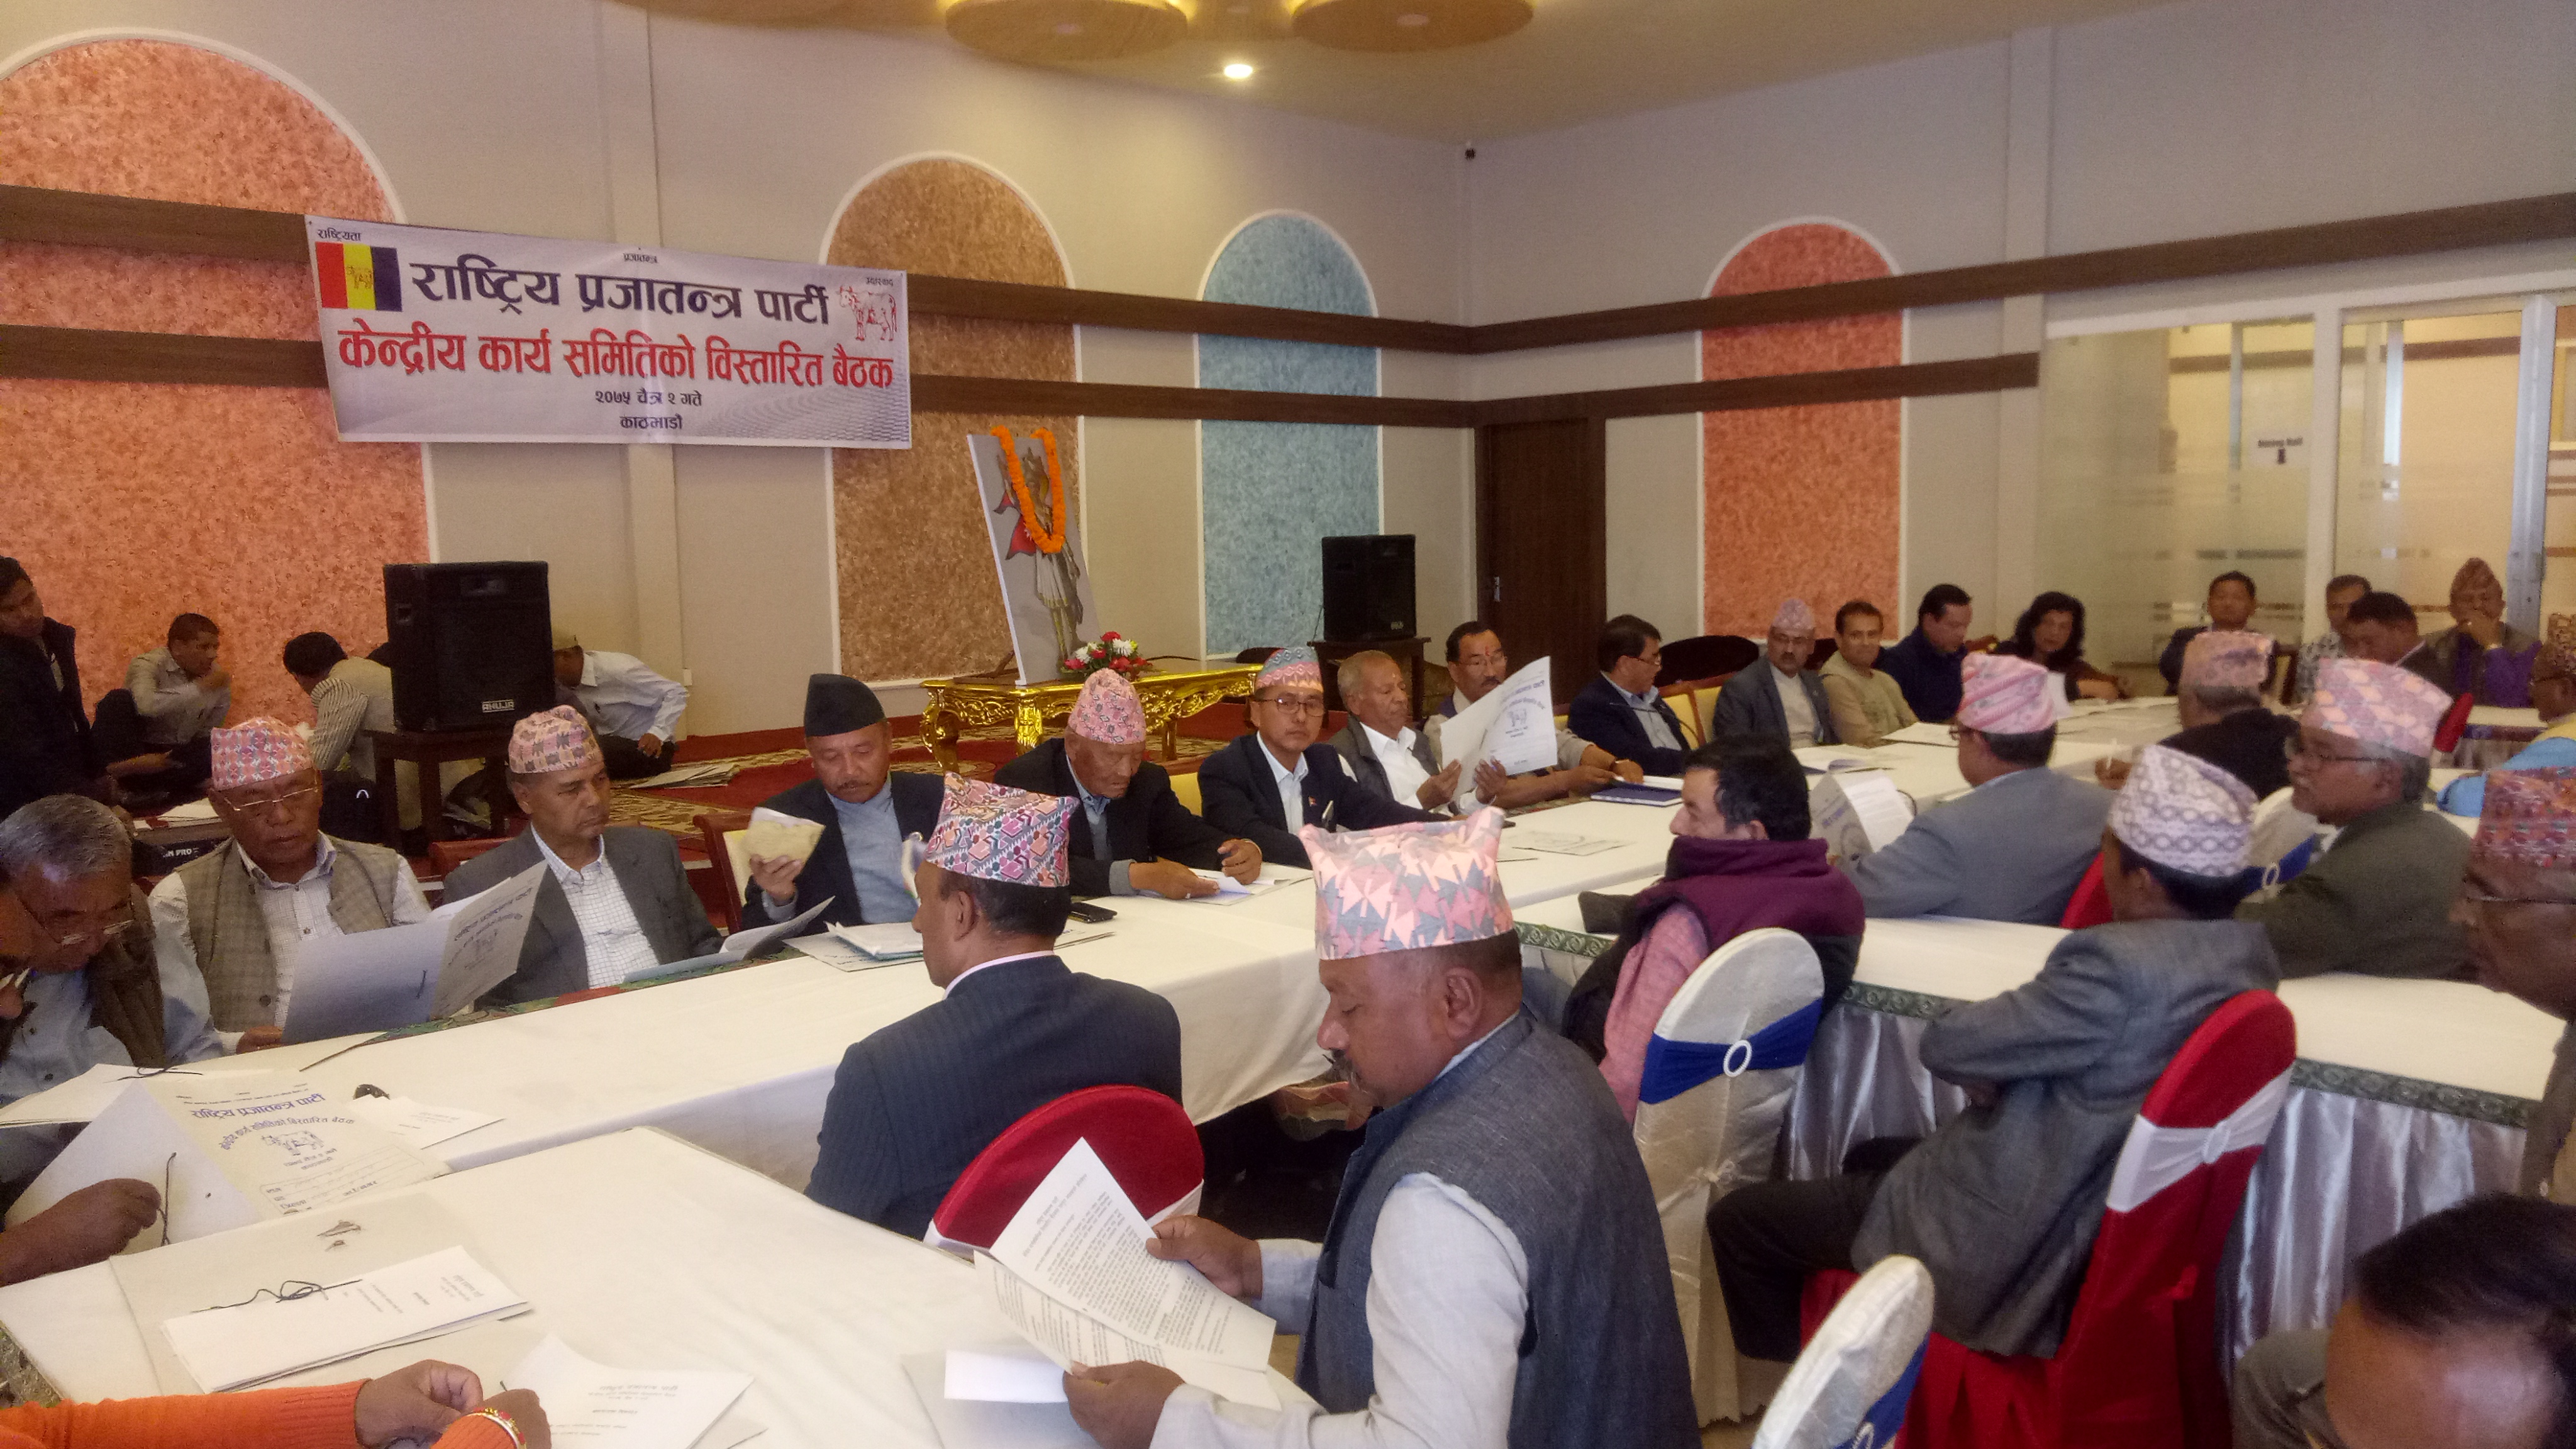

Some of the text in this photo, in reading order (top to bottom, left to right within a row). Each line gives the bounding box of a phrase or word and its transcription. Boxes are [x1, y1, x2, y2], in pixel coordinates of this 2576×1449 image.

[318, 228, 362, 241] राष्ट्रियता
[409, 253, 829, 325] राष्ट्रिय प्रजातन्त्र पार्टी
[337, 317, 894, 387] केन्द्रीय कार्य समितिको विस्तारित बैठक
[596, 387, 702, 406] २०७५ चैत्र २ गते
[482, 701, 514, 711] AHUJA
